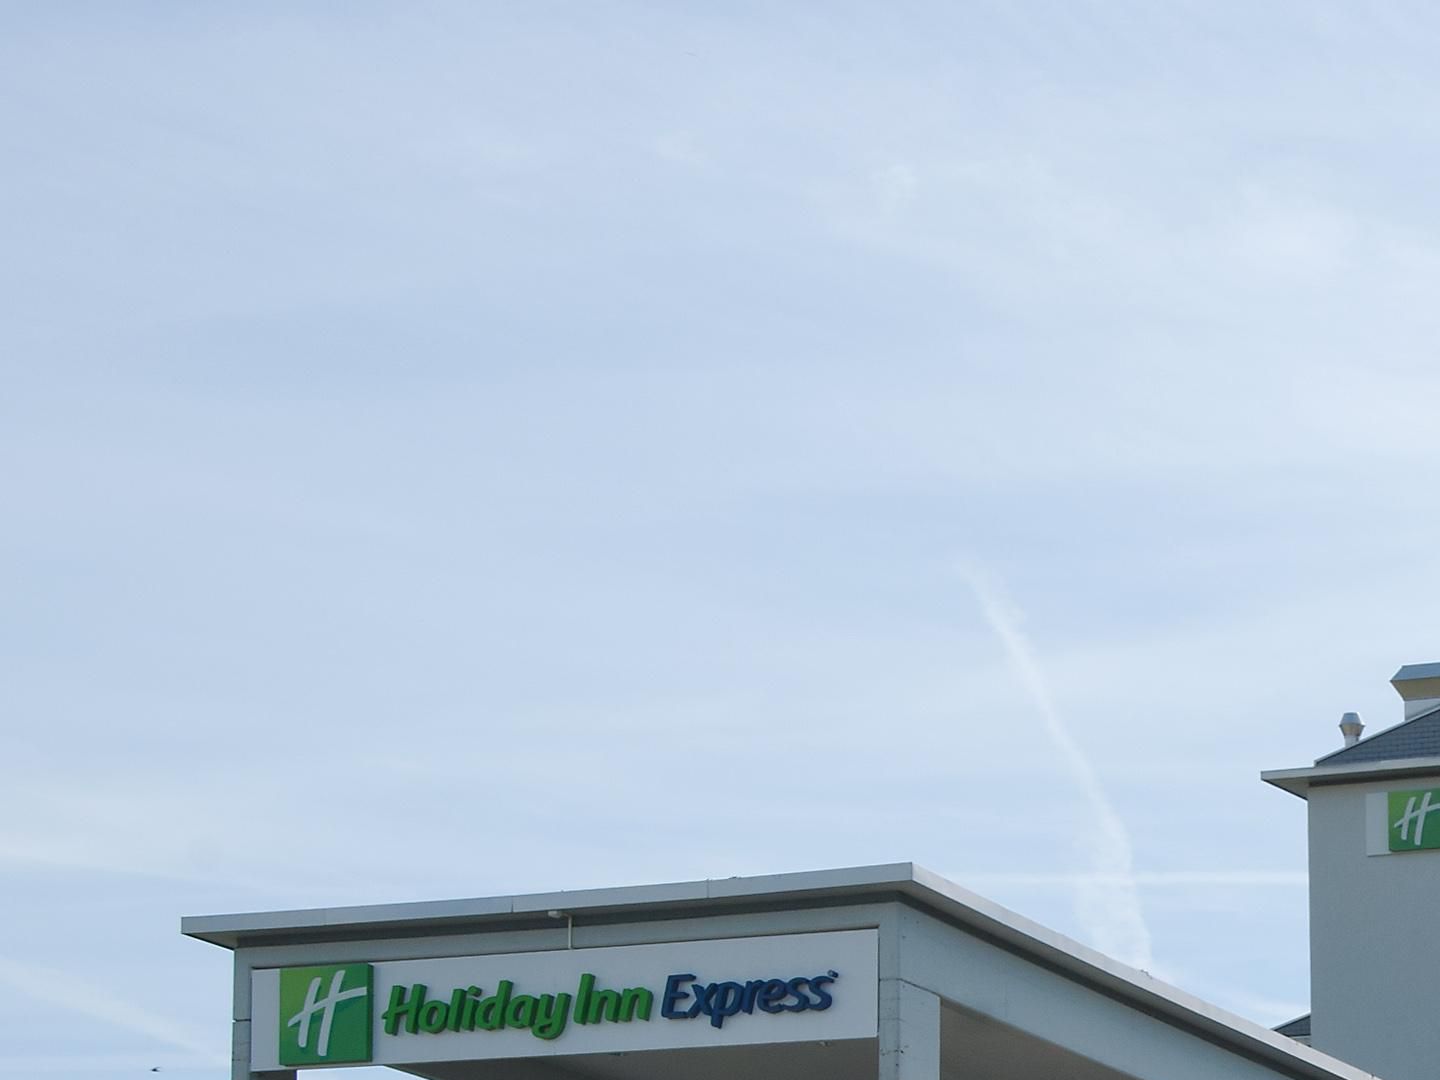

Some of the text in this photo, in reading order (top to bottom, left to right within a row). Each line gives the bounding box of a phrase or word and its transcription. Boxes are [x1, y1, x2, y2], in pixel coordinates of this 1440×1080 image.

[382, 979, 571, 1040] Holiday
[573, 973, 653, 1025] Inn
[661, 972, 836, 1029] Express
